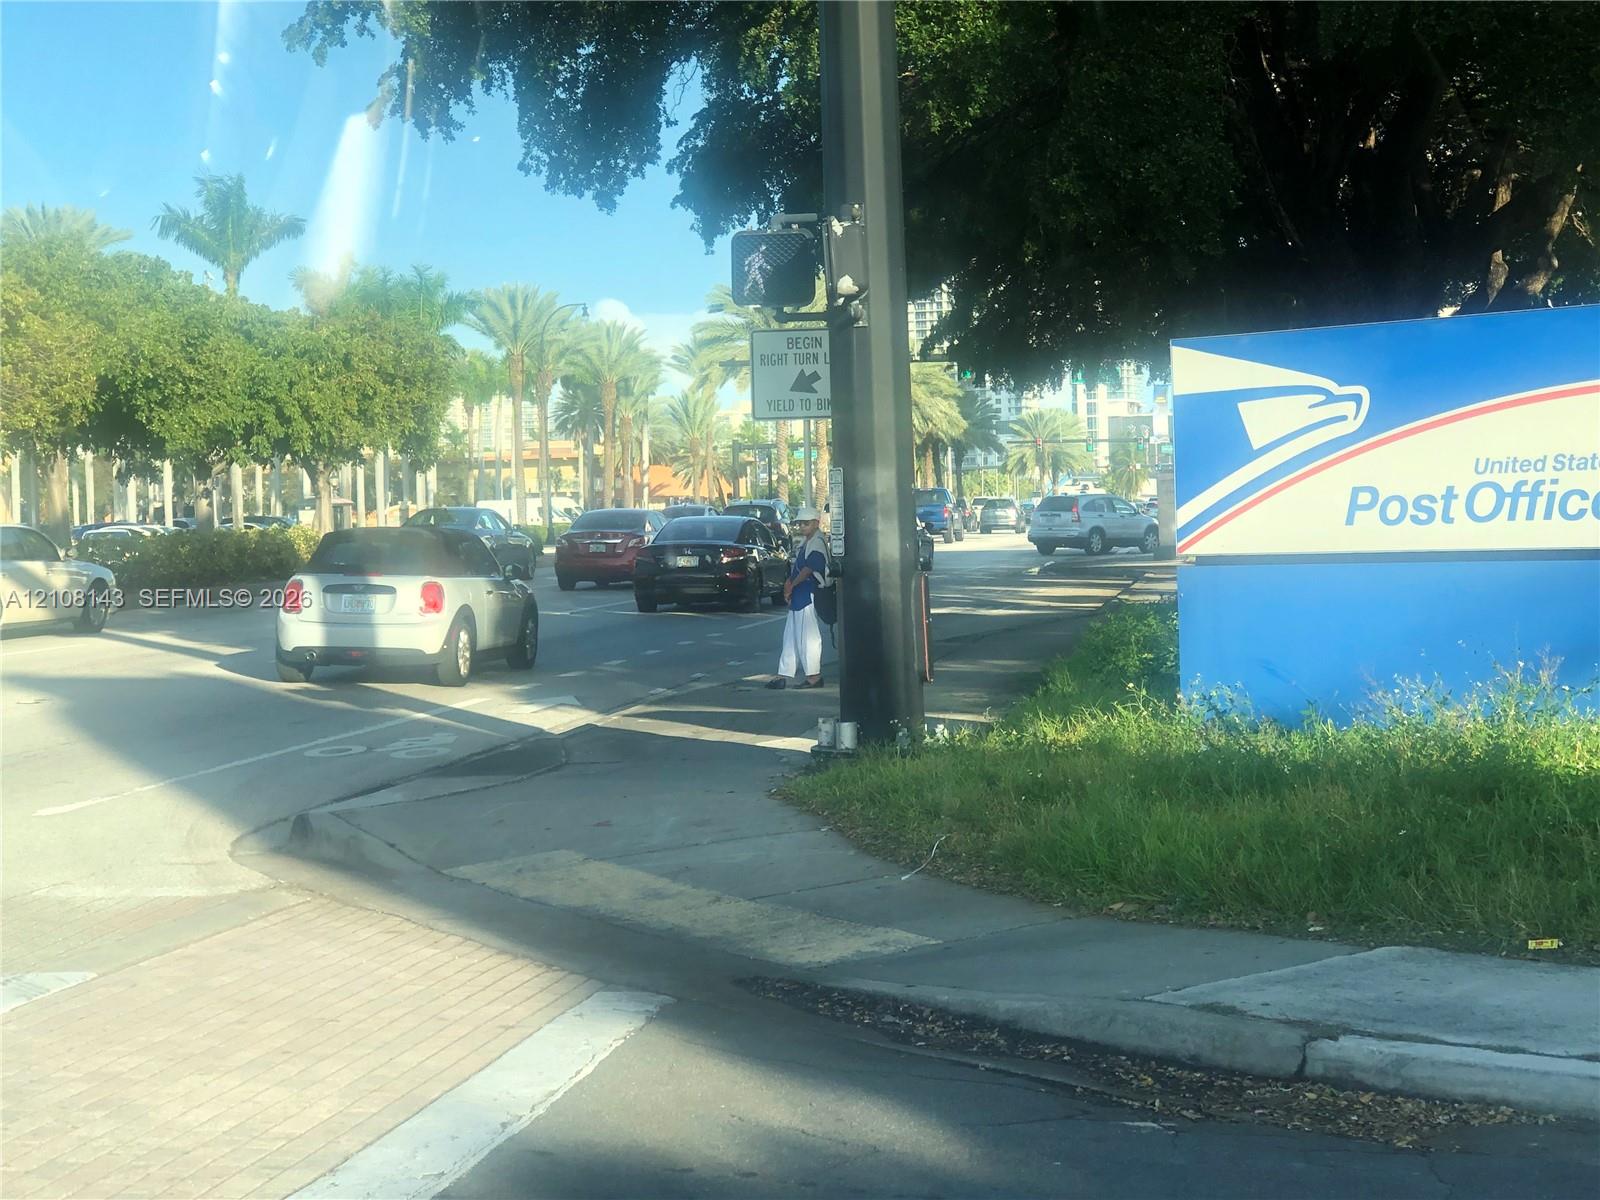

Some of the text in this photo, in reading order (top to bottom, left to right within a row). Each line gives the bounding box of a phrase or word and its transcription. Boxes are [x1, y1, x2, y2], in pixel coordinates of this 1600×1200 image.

[786, 336, 823, 350] BEGIN
[759, 353, 789, 367] RIGHT
[793, 351, 819, 366] TURN
[766, 399, 795, 412] YIELD
[799, 398, 812, 411] TO
[1474, 452, 1600, 474] United Stat
[1344, 485, 1459, 525] Post
